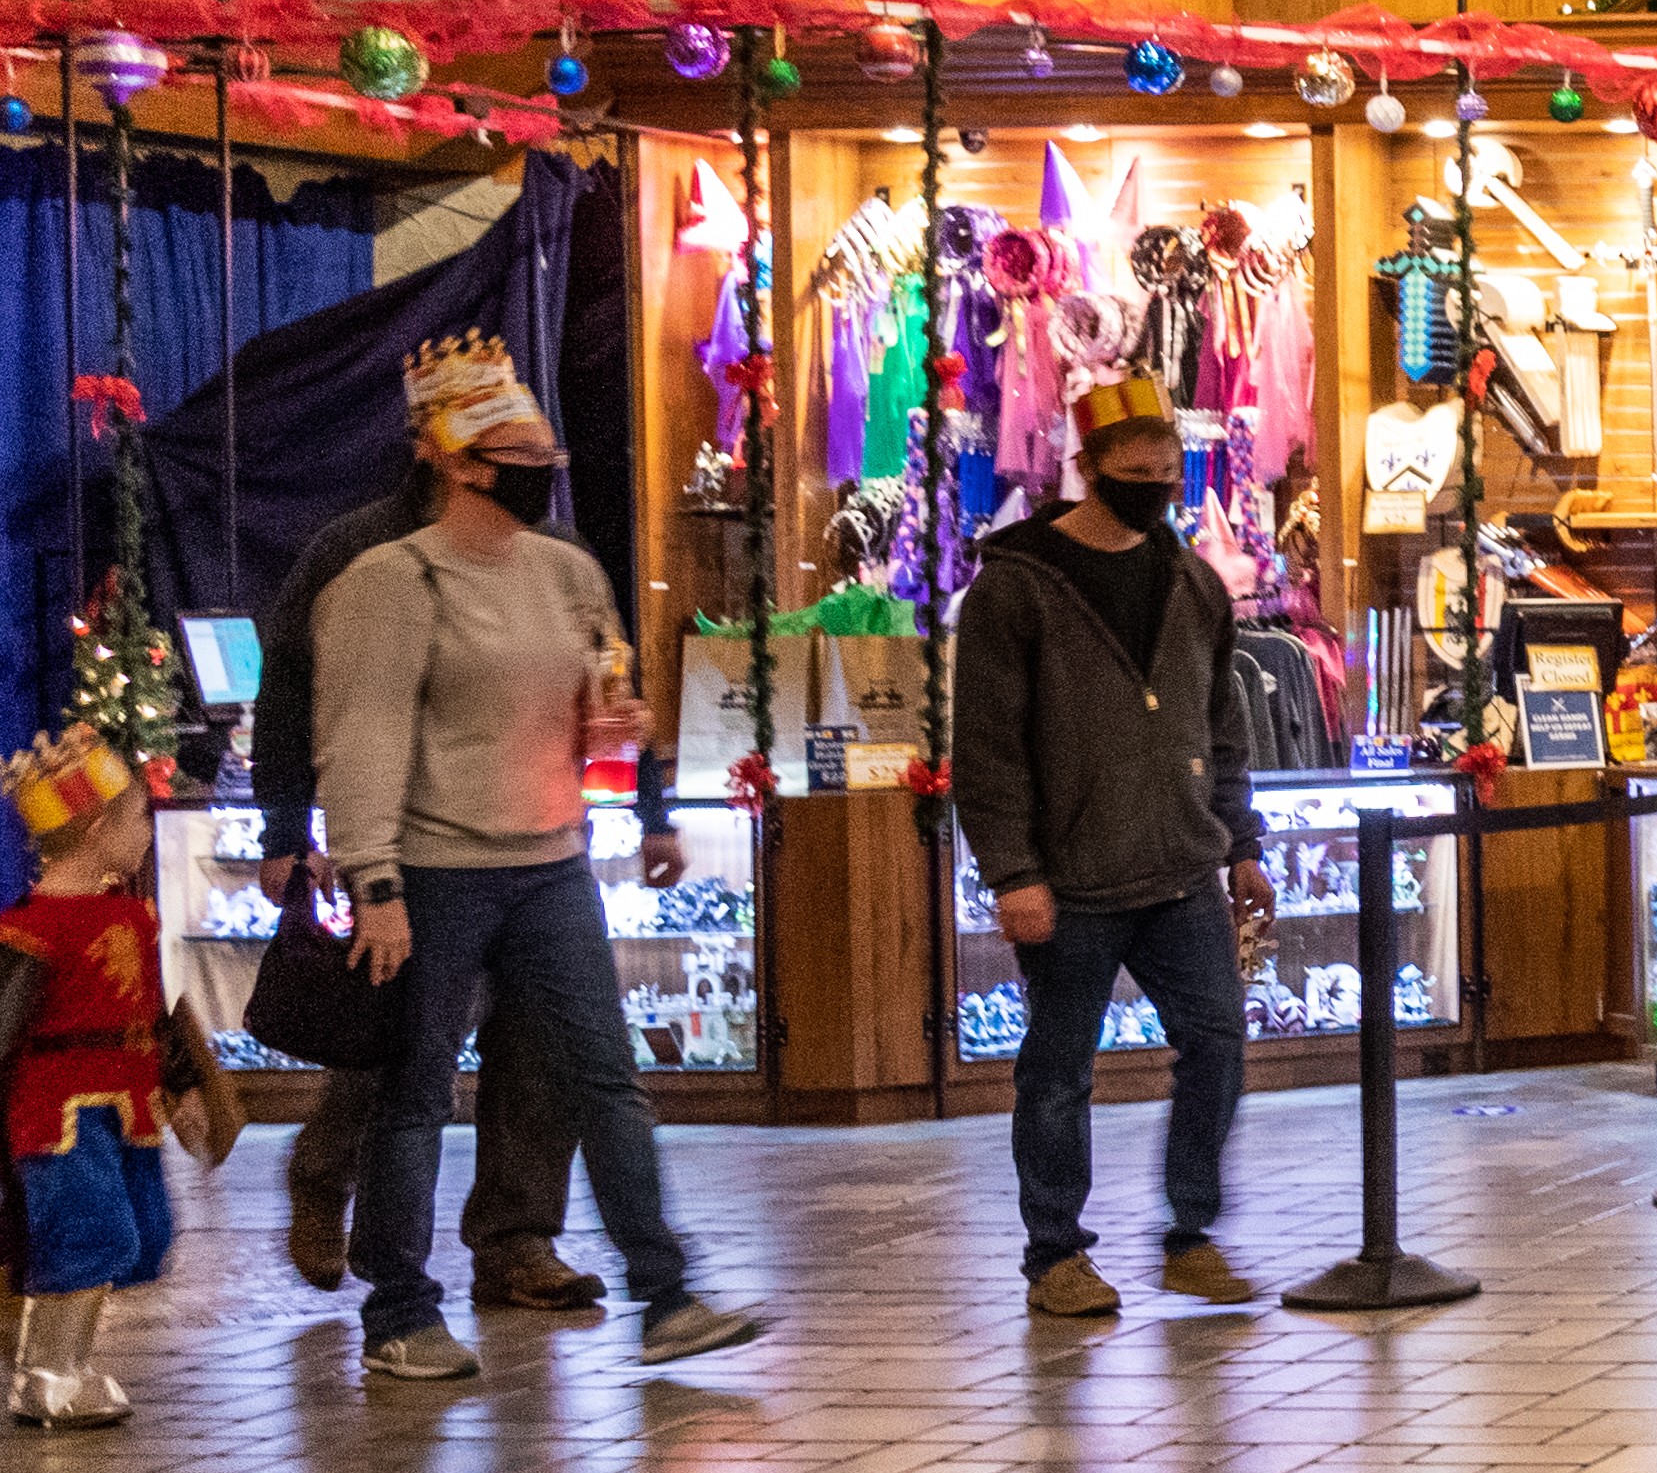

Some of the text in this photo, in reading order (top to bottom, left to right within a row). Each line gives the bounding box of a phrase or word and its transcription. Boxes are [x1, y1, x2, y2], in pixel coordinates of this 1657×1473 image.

[1534, 650, 1591, 665] Register
[1541, 667, 1591, 684] Closed
[1360, 745, 1375, 756] All
[1367, 757, 1394, 768] Final
